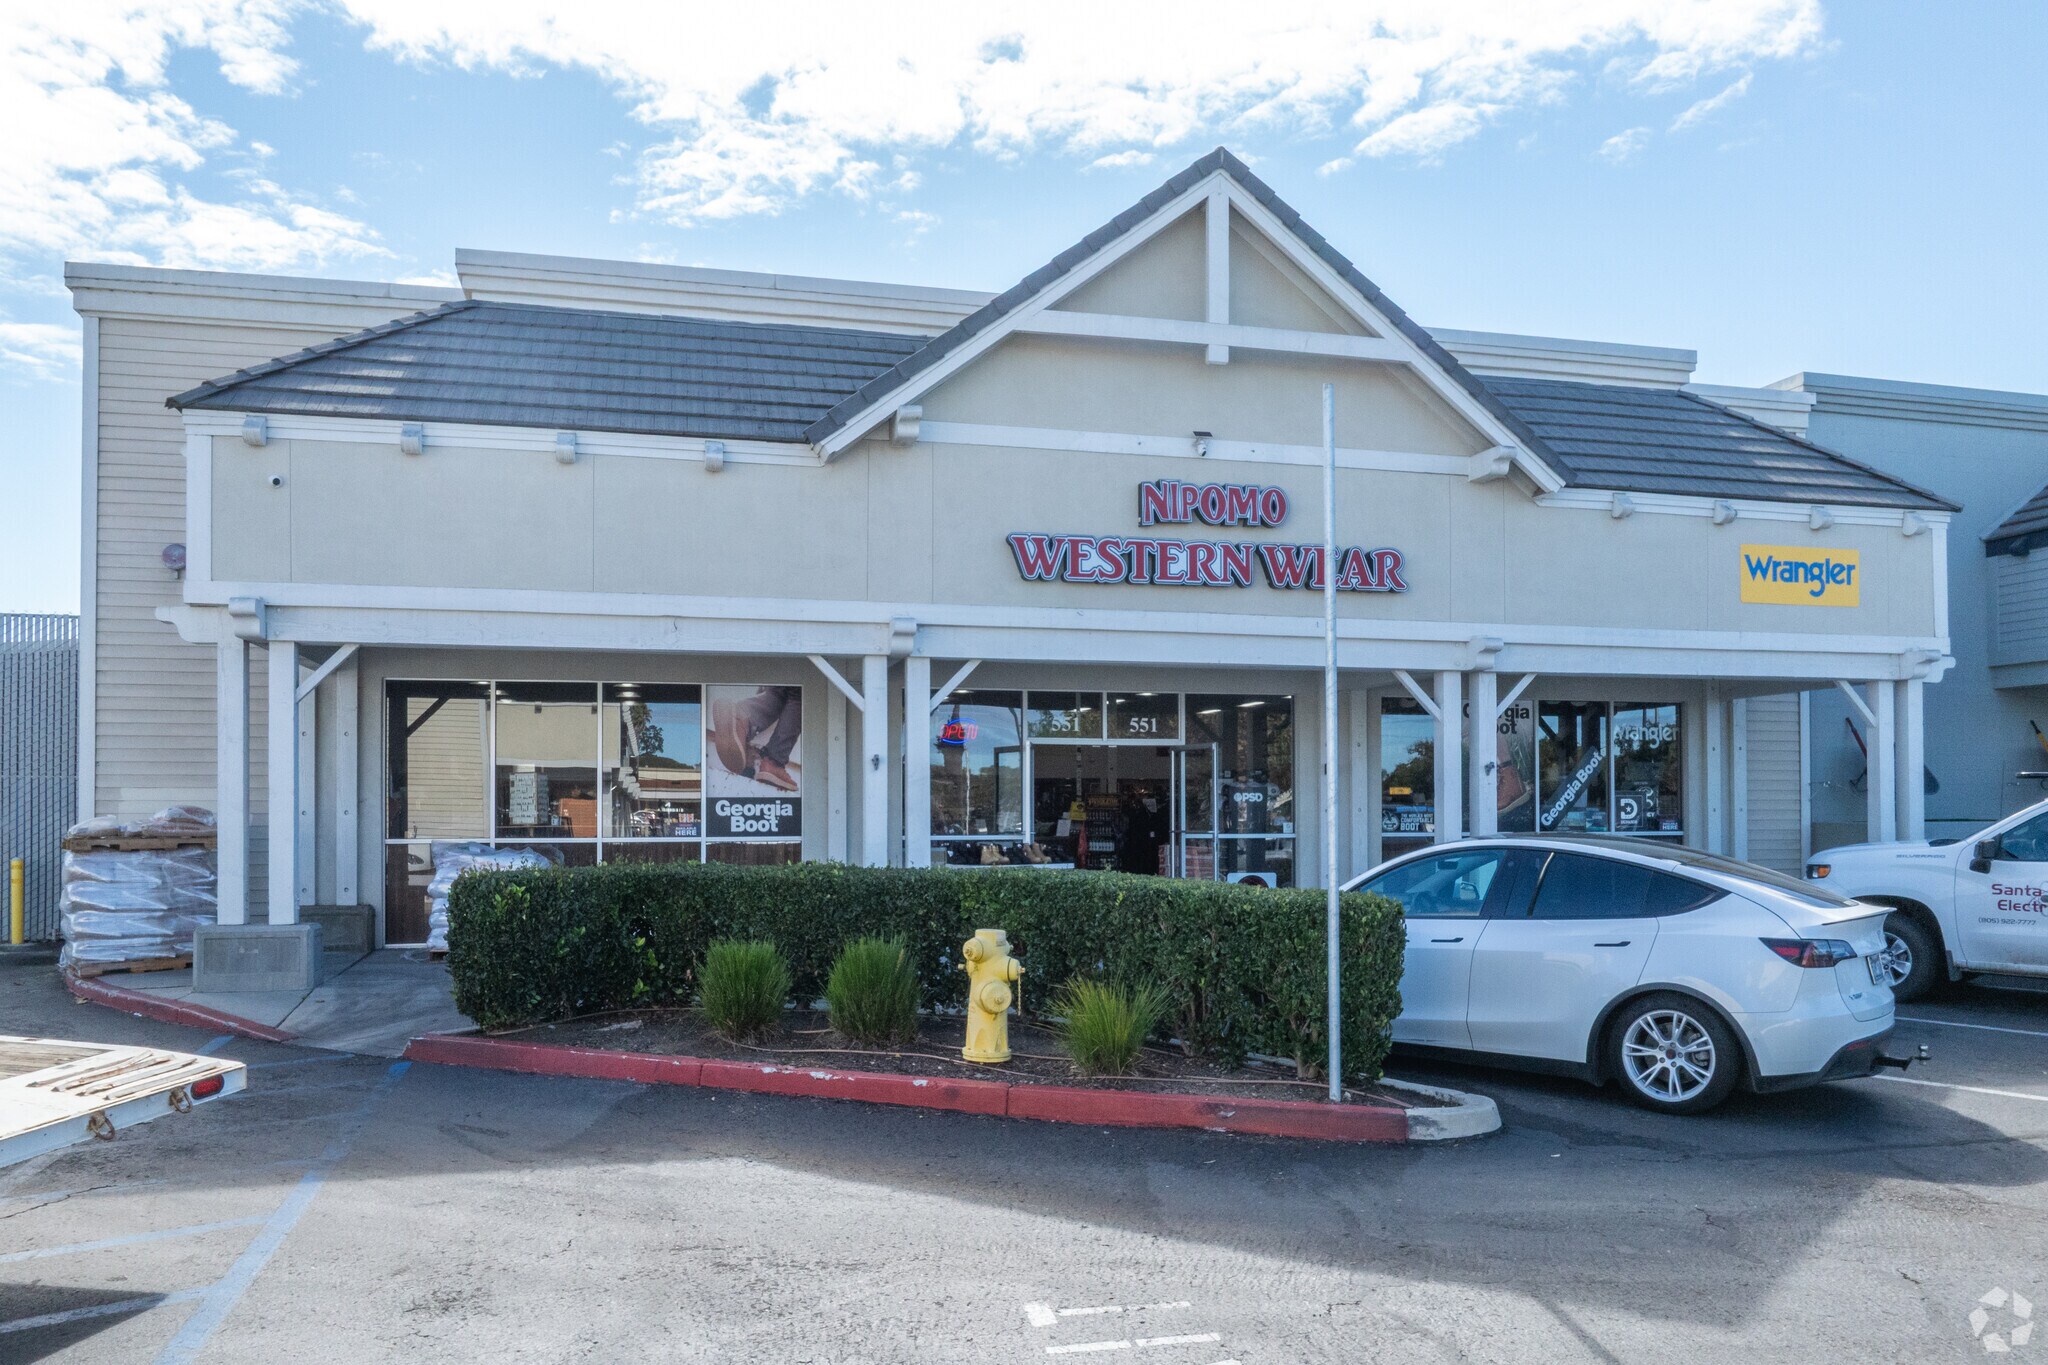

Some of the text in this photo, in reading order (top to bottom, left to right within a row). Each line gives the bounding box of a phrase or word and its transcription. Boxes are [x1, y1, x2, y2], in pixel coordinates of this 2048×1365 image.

[1139, 479, 1289, 527] NIPOMO
[1007, 532, 1408, 592] WESTERN WEAR
[1744, 554, 1855, 597] Wrangler
[939, 723, 979, 740] OPEN
[1051, 717, 1080, 732] 551
[1129, 717, 1158, 733] 551
[1541, 780, 1582, 826] Georgia
[1576, 751, 1603, 783] Boot
[1242, 792, 1264, 802] PSD
[715, 799, 793, 820] Georgia
[730, 816, 779, 833] Boot
[1400, 822, 1420, 831] BOOT
[1991, 883, 2042, 897] Santa
[1997, 899, 2048, 913] Electr
[1978, 917, 2037, 926] (805) 922-7777
